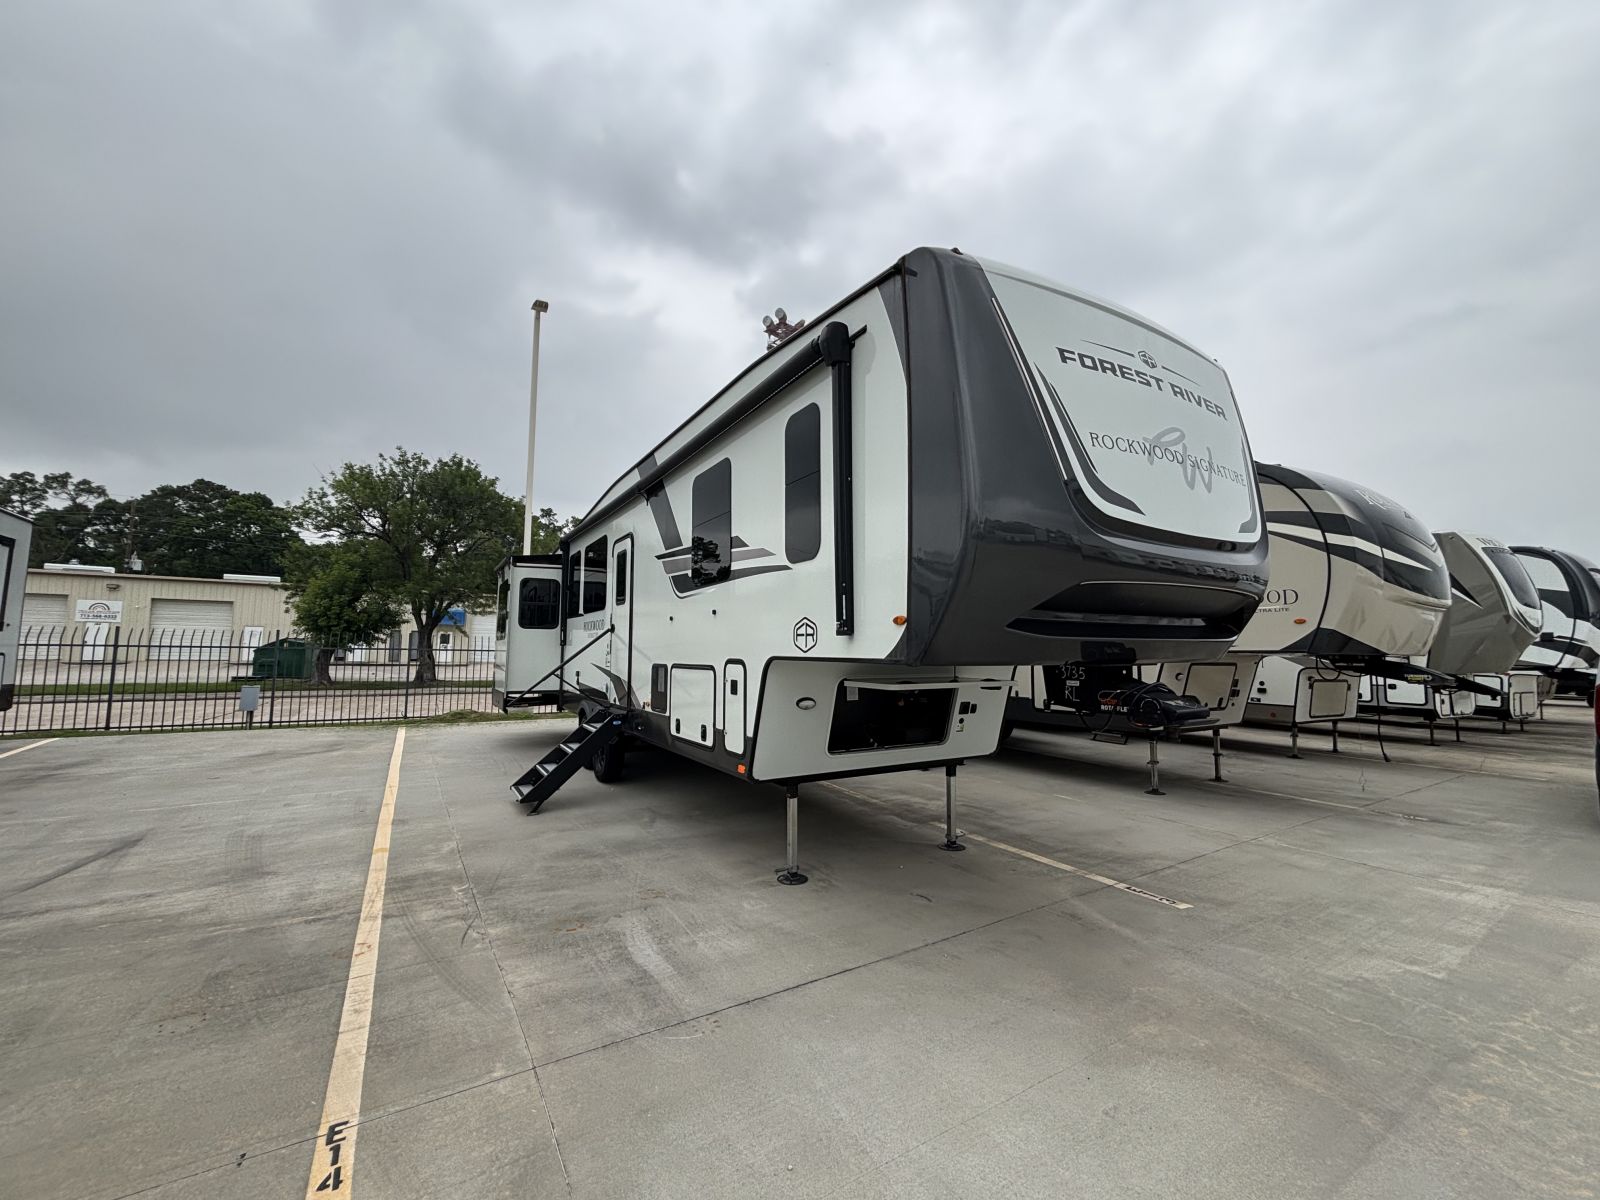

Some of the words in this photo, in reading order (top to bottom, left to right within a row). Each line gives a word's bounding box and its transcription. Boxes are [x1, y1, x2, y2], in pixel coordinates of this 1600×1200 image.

[1056, 346, 1164, 392] FOREST
[1168, 382, 1228, 421] RIVER
[1089, 431, 1184, 465] ROCKWOOD
[1187, 454, 1247, 487] SIGNATURE
[1266, 589, 1299, 605] OD
[315, 1120, 349, 1192] E14
